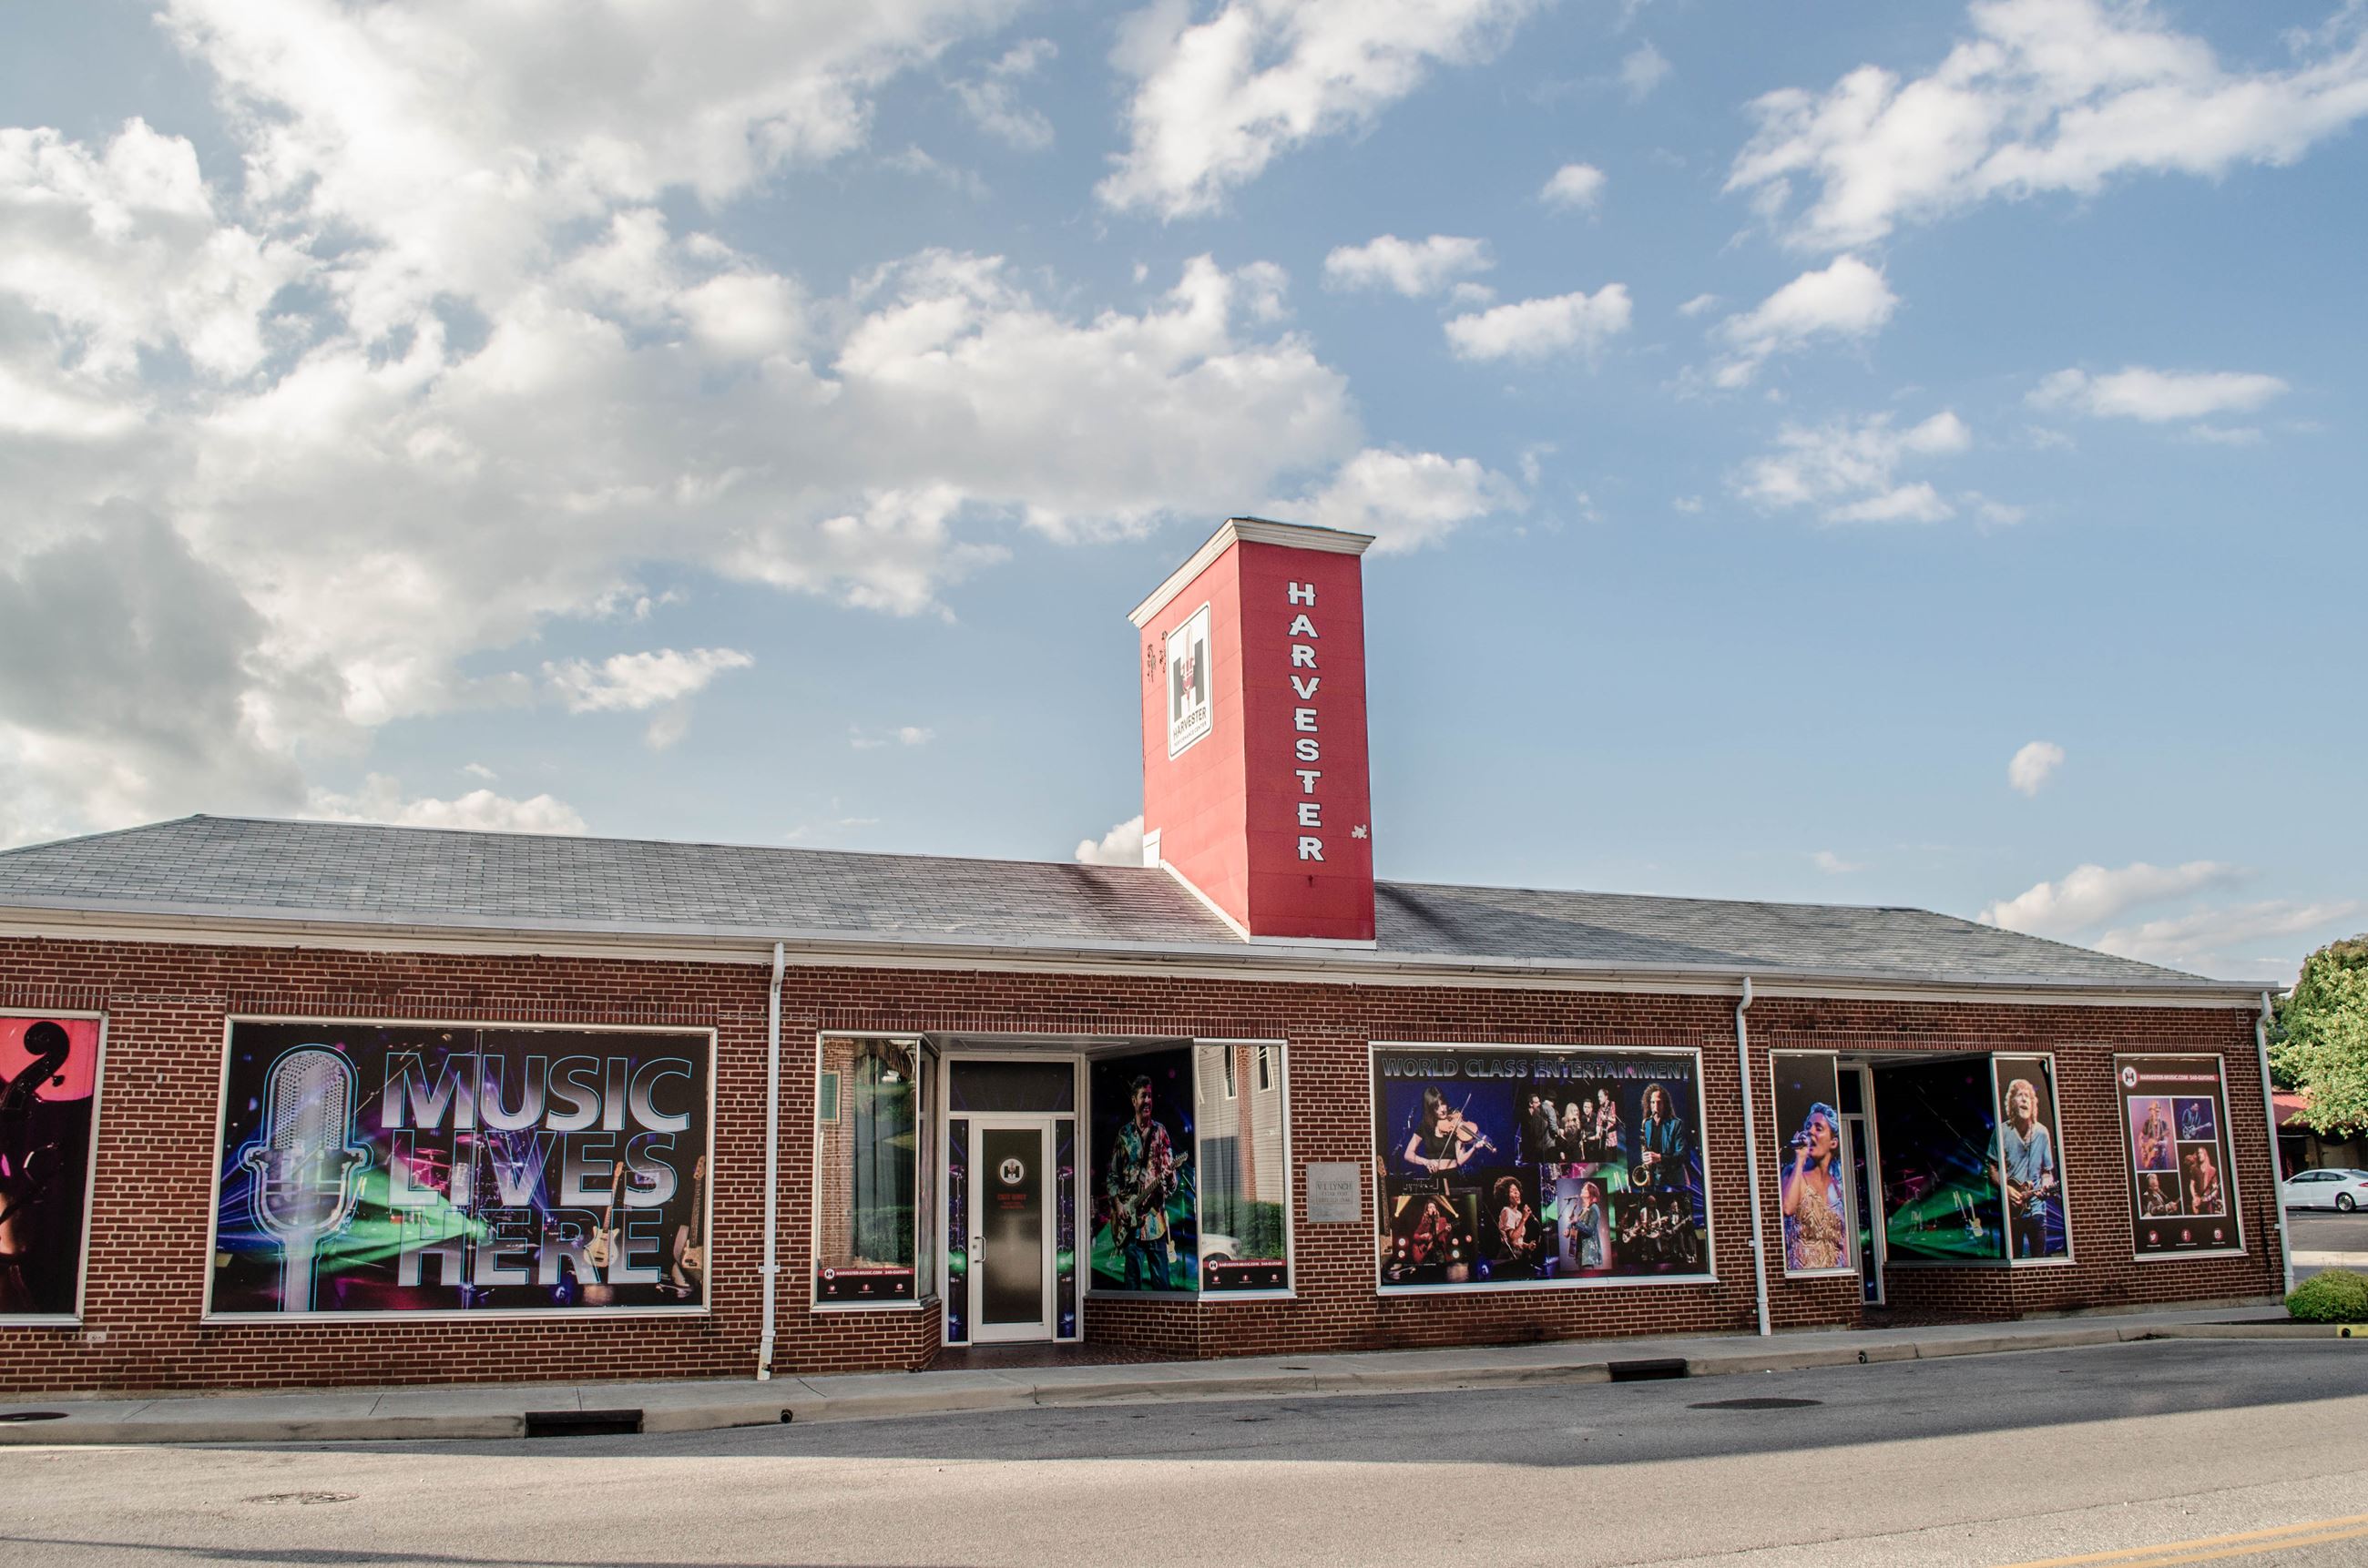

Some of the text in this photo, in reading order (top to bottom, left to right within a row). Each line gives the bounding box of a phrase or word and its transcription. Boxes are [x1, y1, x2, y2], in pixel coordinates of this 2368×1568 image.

[1173, 706, 1207, 740] HARVESTER
[1287, 581, 1325, 861] HARVESTER
[382, 1053, 692, 1133] MUSIC
[1381, 1057, 1691, 1080] WORLD CLASS ENTERTAINMENT
[387, 1129, 678, 1207] LIVES
[398, 1208, 663, 1286] HERE
